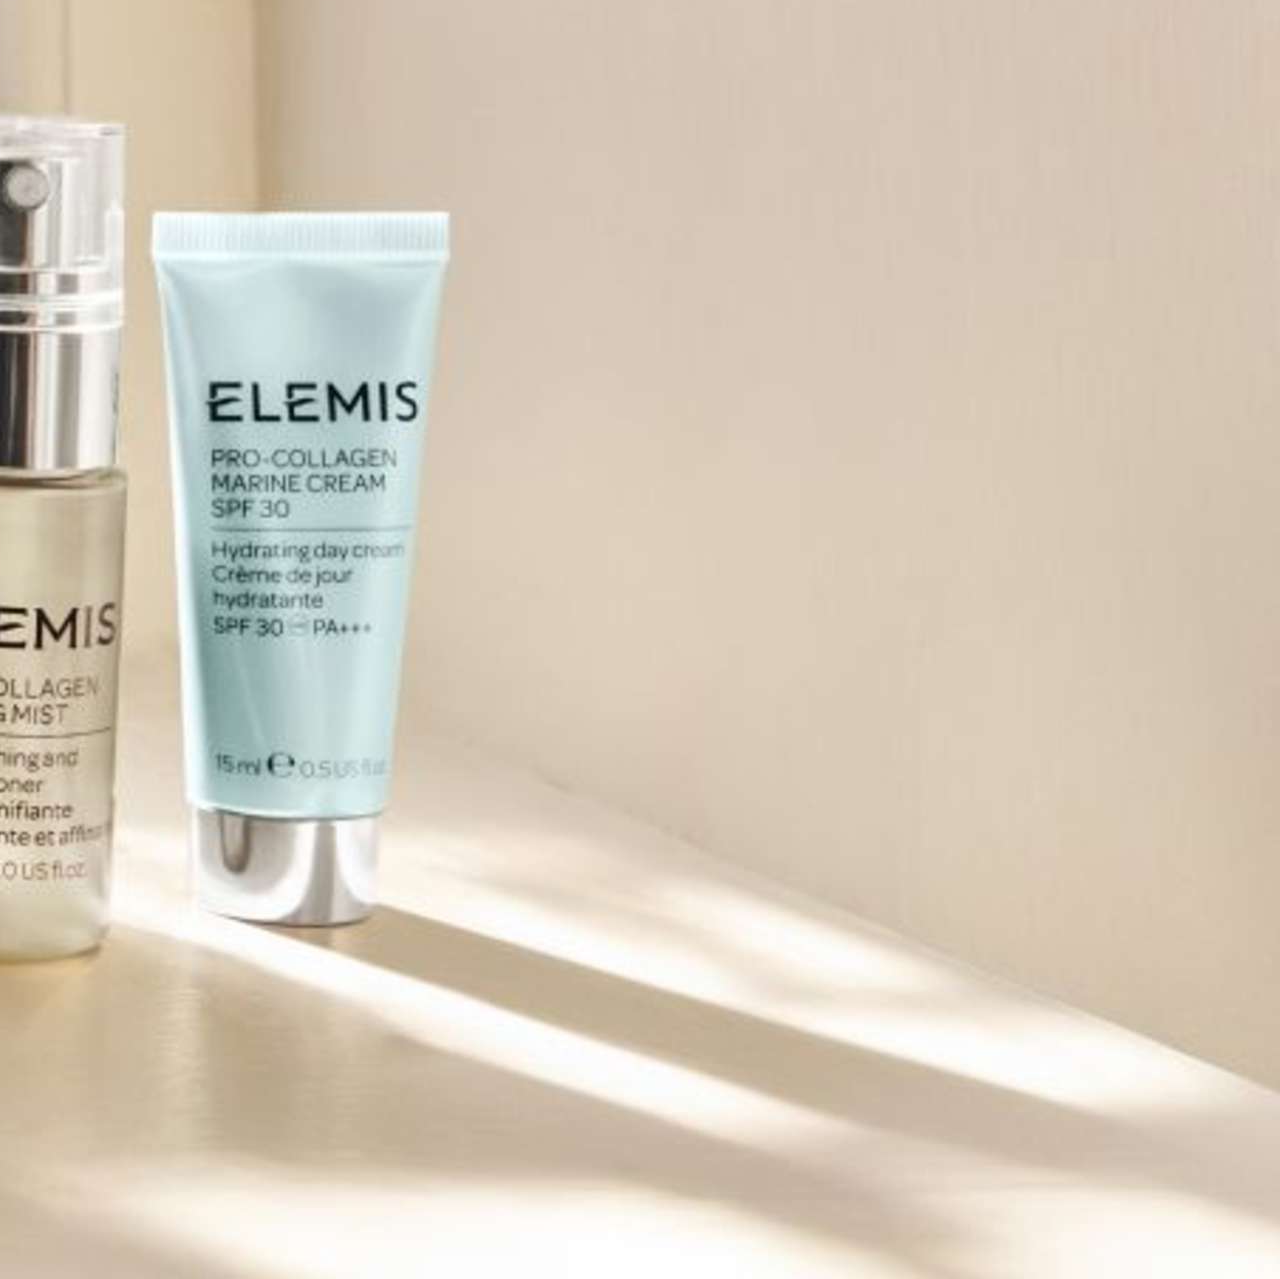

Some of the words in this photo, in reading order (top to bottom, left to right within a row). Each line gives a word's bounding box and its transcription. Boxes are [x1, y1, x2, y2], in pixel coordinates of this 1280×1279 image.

[206, 380, 419, 423] ELEMIS
[210, 448, 397, 468] PRO-COLLAGEN
[210, 473, 302, 493] MARINE
[306, 474, 386, 493] CREAM
[210, 498, 255, 519] SPF
[259, 498, 290, 519] 30
[210, 541, 310, 564] Hydrating
[313, 542, 349, 561] day
[286, 566, 312, 584] de
[314, 568, 354, 588] jour
[212, 589, 324, 610] hydratante
[213, 616, 252, 636] SPF
[256, 617, 284, 637] 30
[10, 703, 69, 726] MIST
[42, 749, 79, 768] and
[34, 828, 54, 847] et
